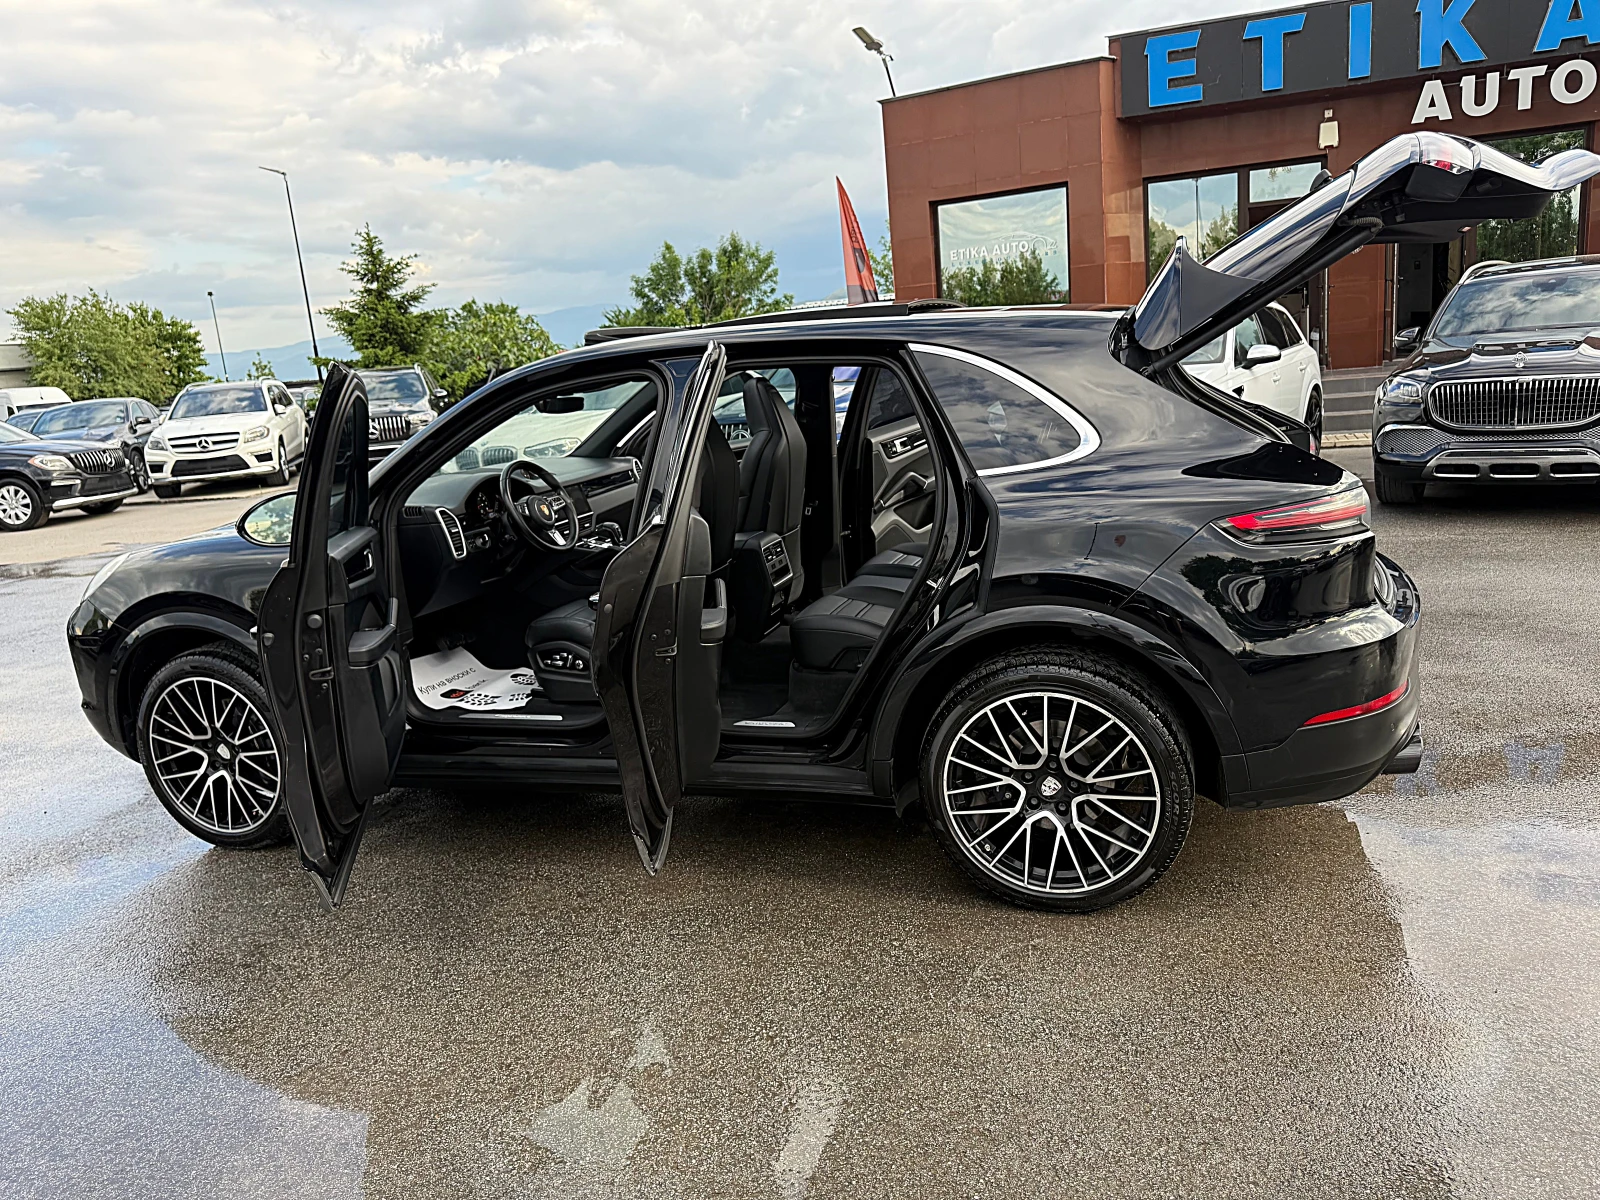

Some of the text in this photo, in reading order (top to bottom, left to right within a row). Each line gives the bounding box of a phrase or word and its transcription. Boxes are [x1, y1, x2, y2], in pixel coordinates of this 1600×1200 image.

[1144, 0, 1600, 107] ETIKA
[1411, 59, 1598, 124] AUTO
[950, 241, 1029, 261] ETIKA AUTO
[418, 682, 437, 695] Купи
[436, 680, 447, 688] на
